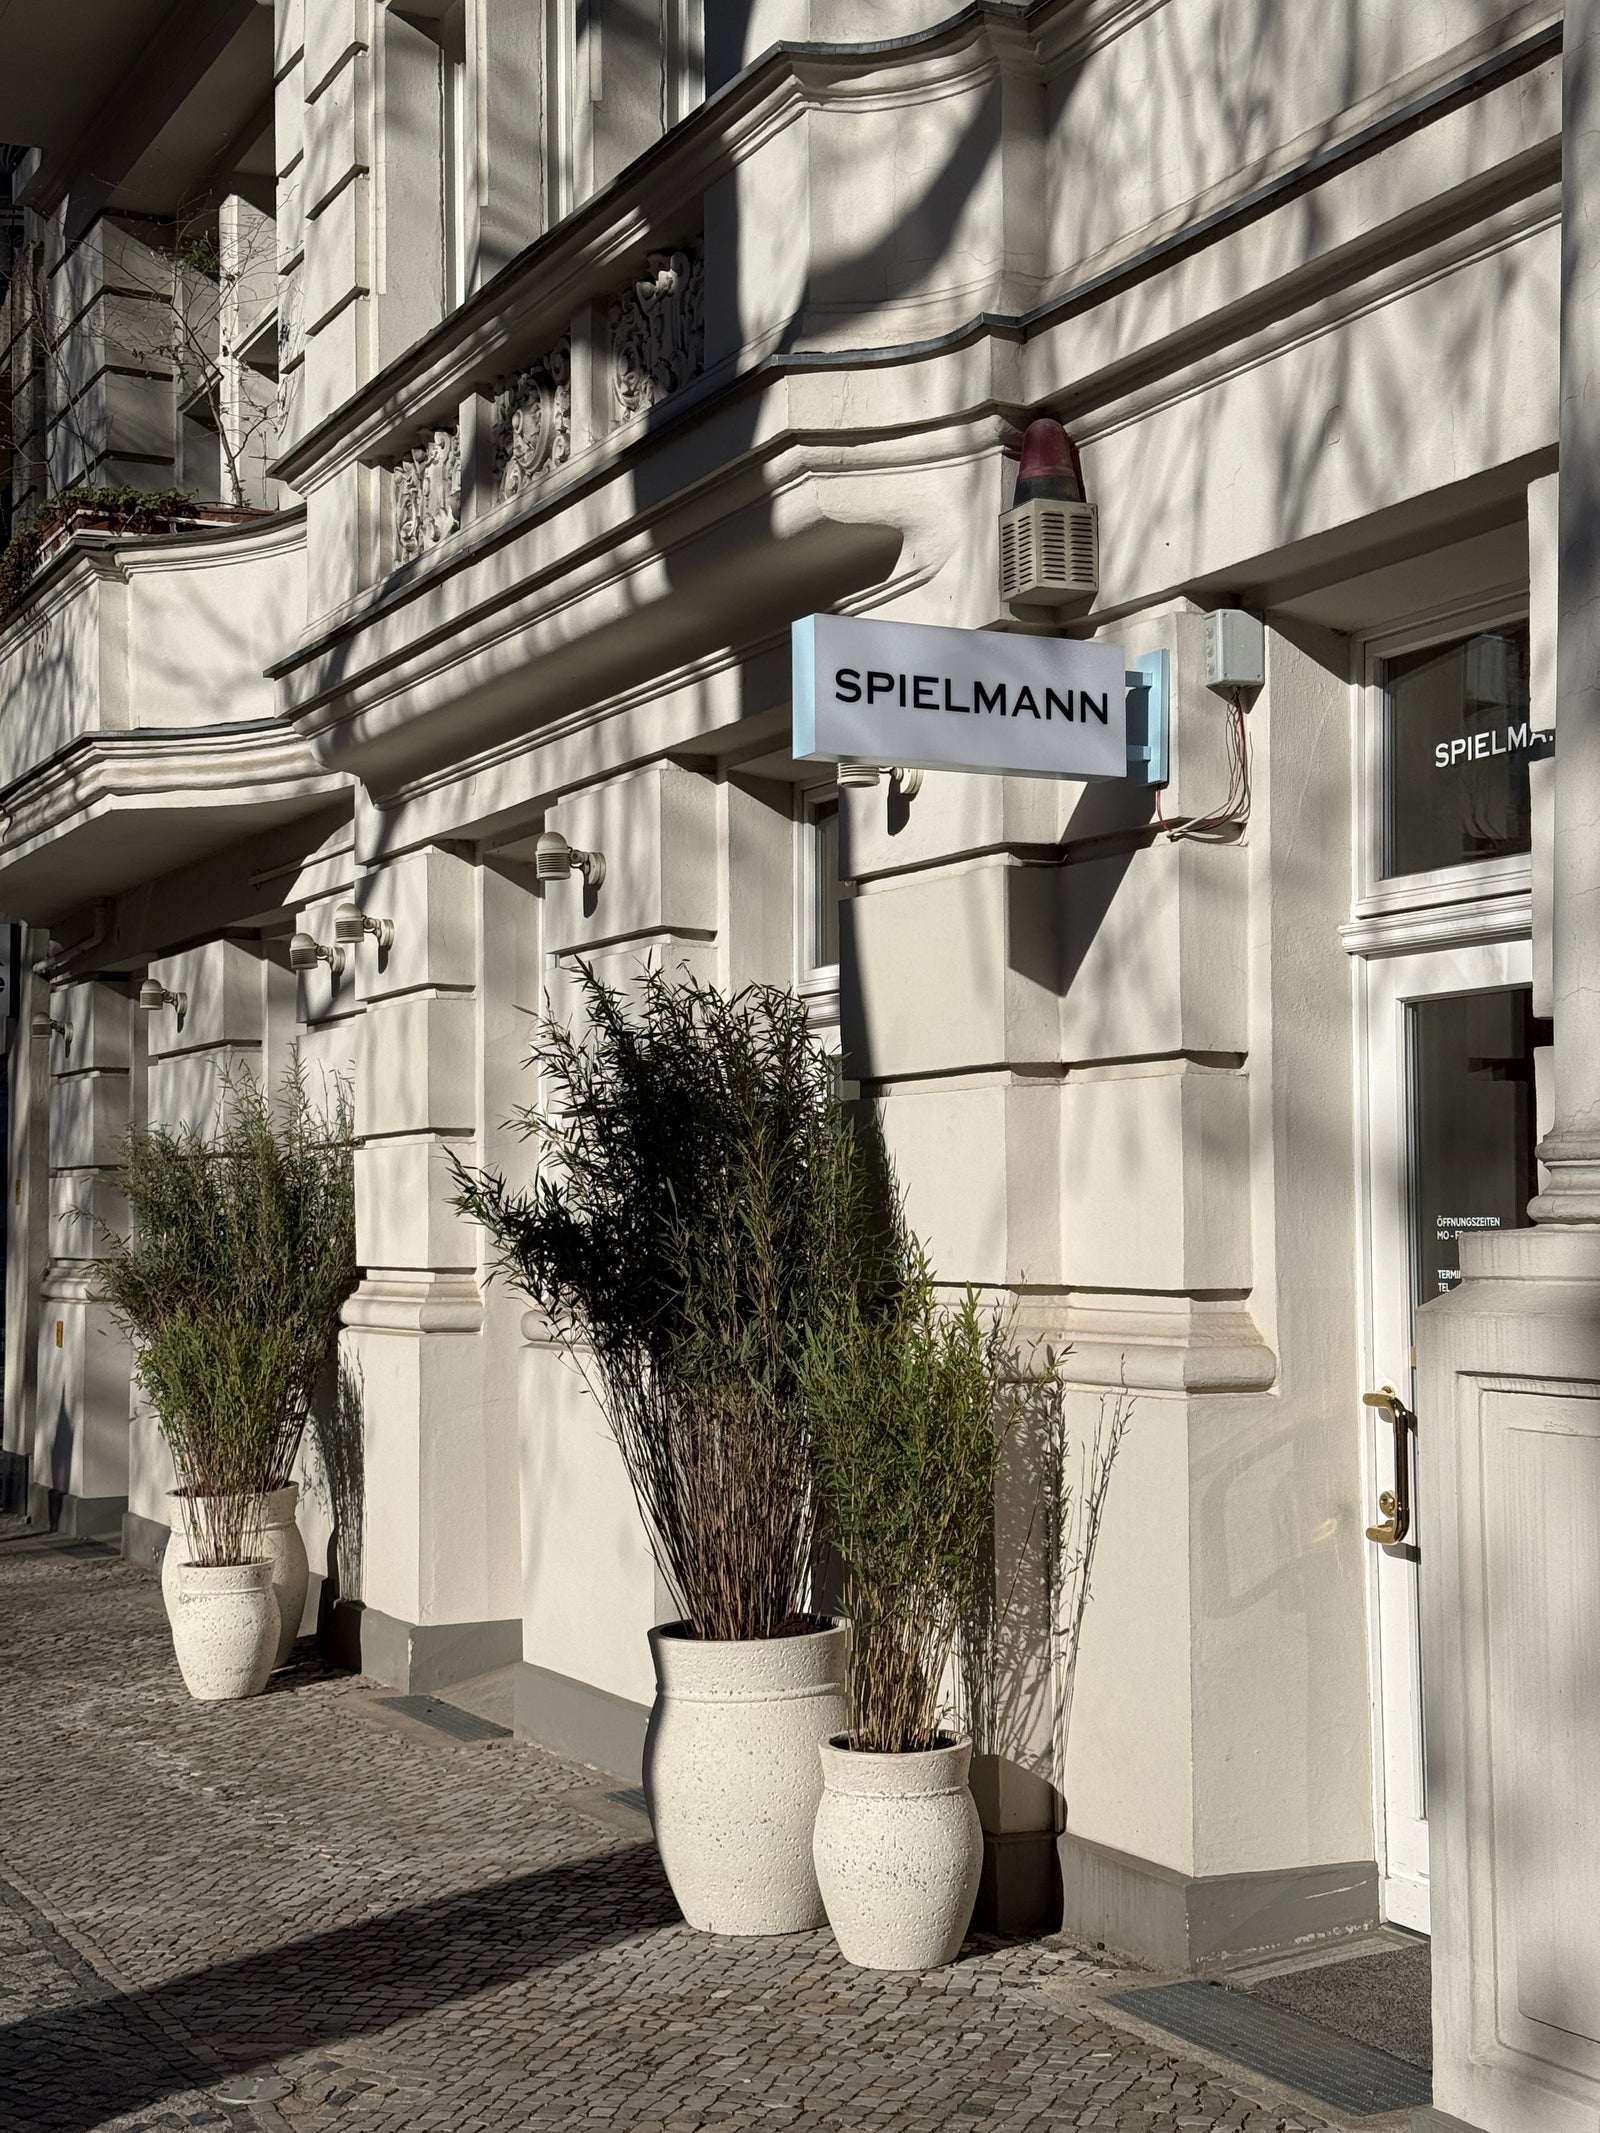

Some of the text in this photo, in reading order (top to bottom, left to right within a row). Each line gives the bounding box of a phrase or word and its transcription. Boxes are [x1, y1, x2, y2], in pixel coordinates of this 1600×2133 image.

[835, 668, 1109, 725] SPIELMANN
[1435, 722, 1554, 768] SPIELMA
[1437, 1215, 1500, 1226] ÖFFNUNGSZEITEN
[1437, 1231, 1449, 1240] MO
[1438, 1283, 1449, 1292] TEL
